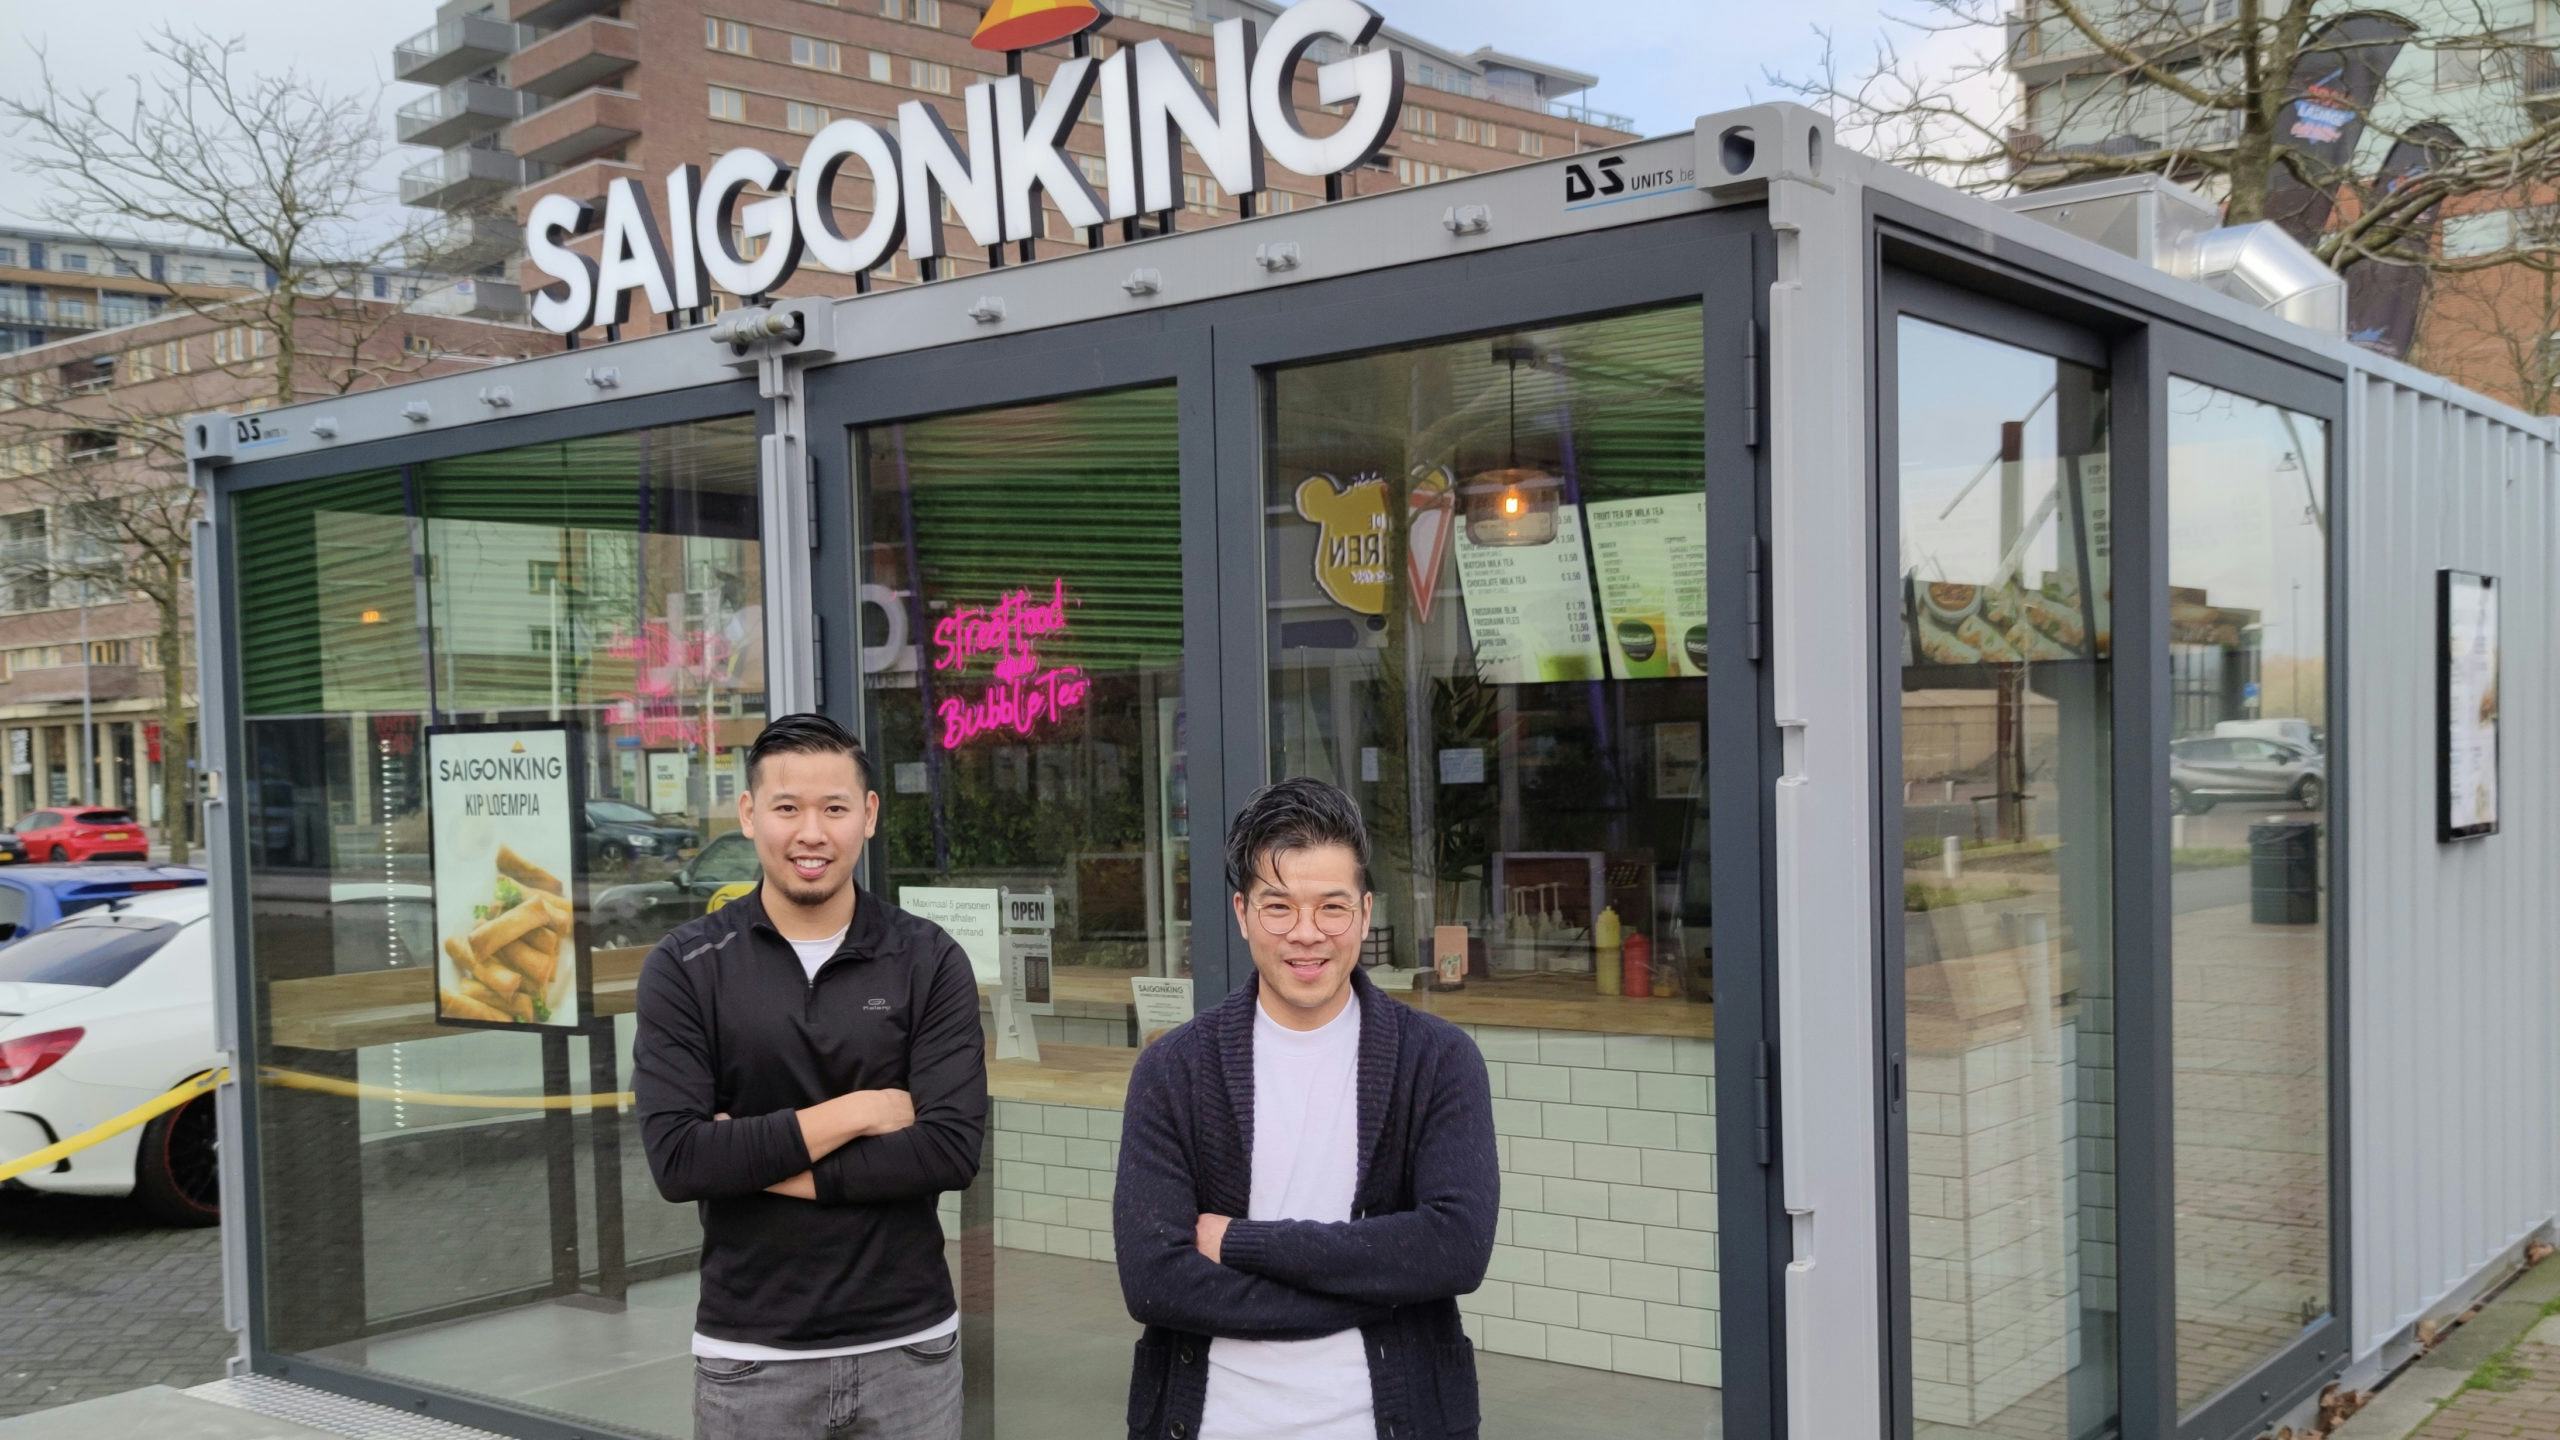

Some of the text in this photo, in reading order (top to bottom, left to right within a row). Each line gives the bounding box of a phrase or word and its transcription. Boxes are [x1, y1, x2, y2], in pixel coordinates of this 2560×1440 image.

[528, 0, 1404, 335] SAIGONKING
[1566, 156, 1625, 202] DS
[1631, 170, 1673, 190] UNITS
[237, 418, 261, 443] DS
[439, 756, 562, 782] SAIGONKING
[465, 793, 540, 816] KIP LOEMPIA
[912, 898, 948, 908] Maximaal
[956, 901, 991, 910] personen
[1011, 901, 1045, 922] OPEN
[951, 914, 977, 923] afhalen
[956, 928, 984, 936] afstand
[1138, 983, 1184, 994] SAIGONKING
